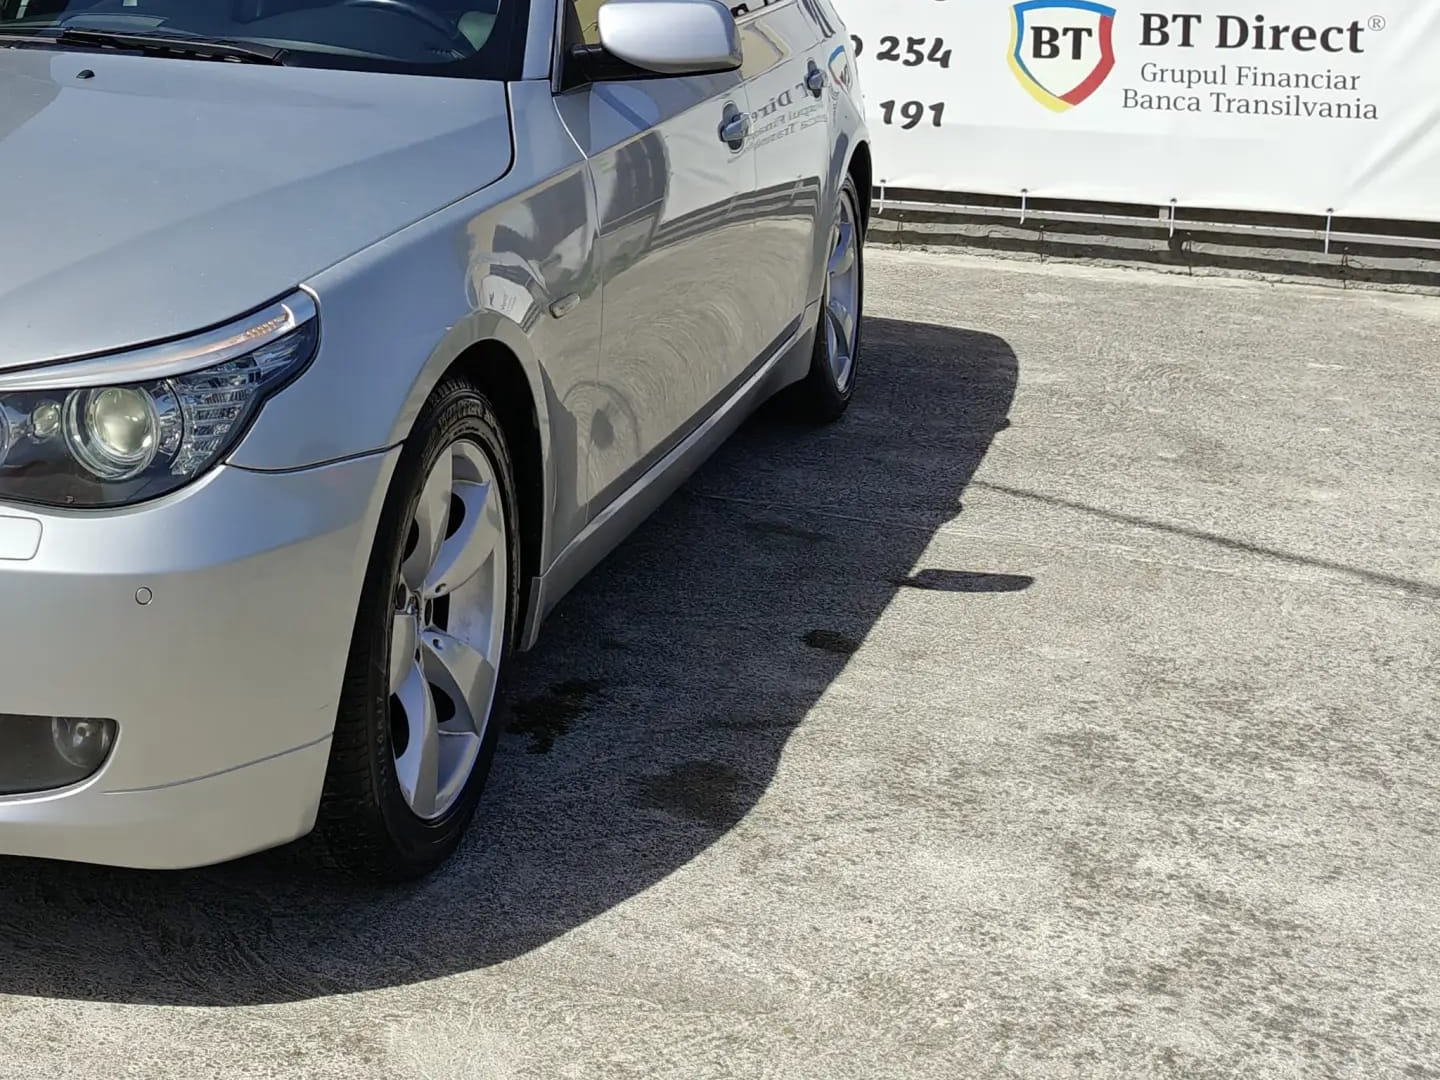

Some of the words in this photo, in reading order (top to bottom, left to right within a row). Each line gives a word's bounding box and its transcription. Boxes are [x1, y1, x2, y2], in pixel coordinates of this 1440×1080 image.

[1030, 25, 1092, 60] BT
[1138, 13, 1202, 48] BT
[876, 35, 952, 68] 254
[1140, 62, 1226, 89] Grupul
[1235, 66, 1361, 91] Financiar
[879, 99, 945, 130] 191
[1121, 88, 1201, 112] Banca
[1210, 91, 1379, 121] Transilvania
